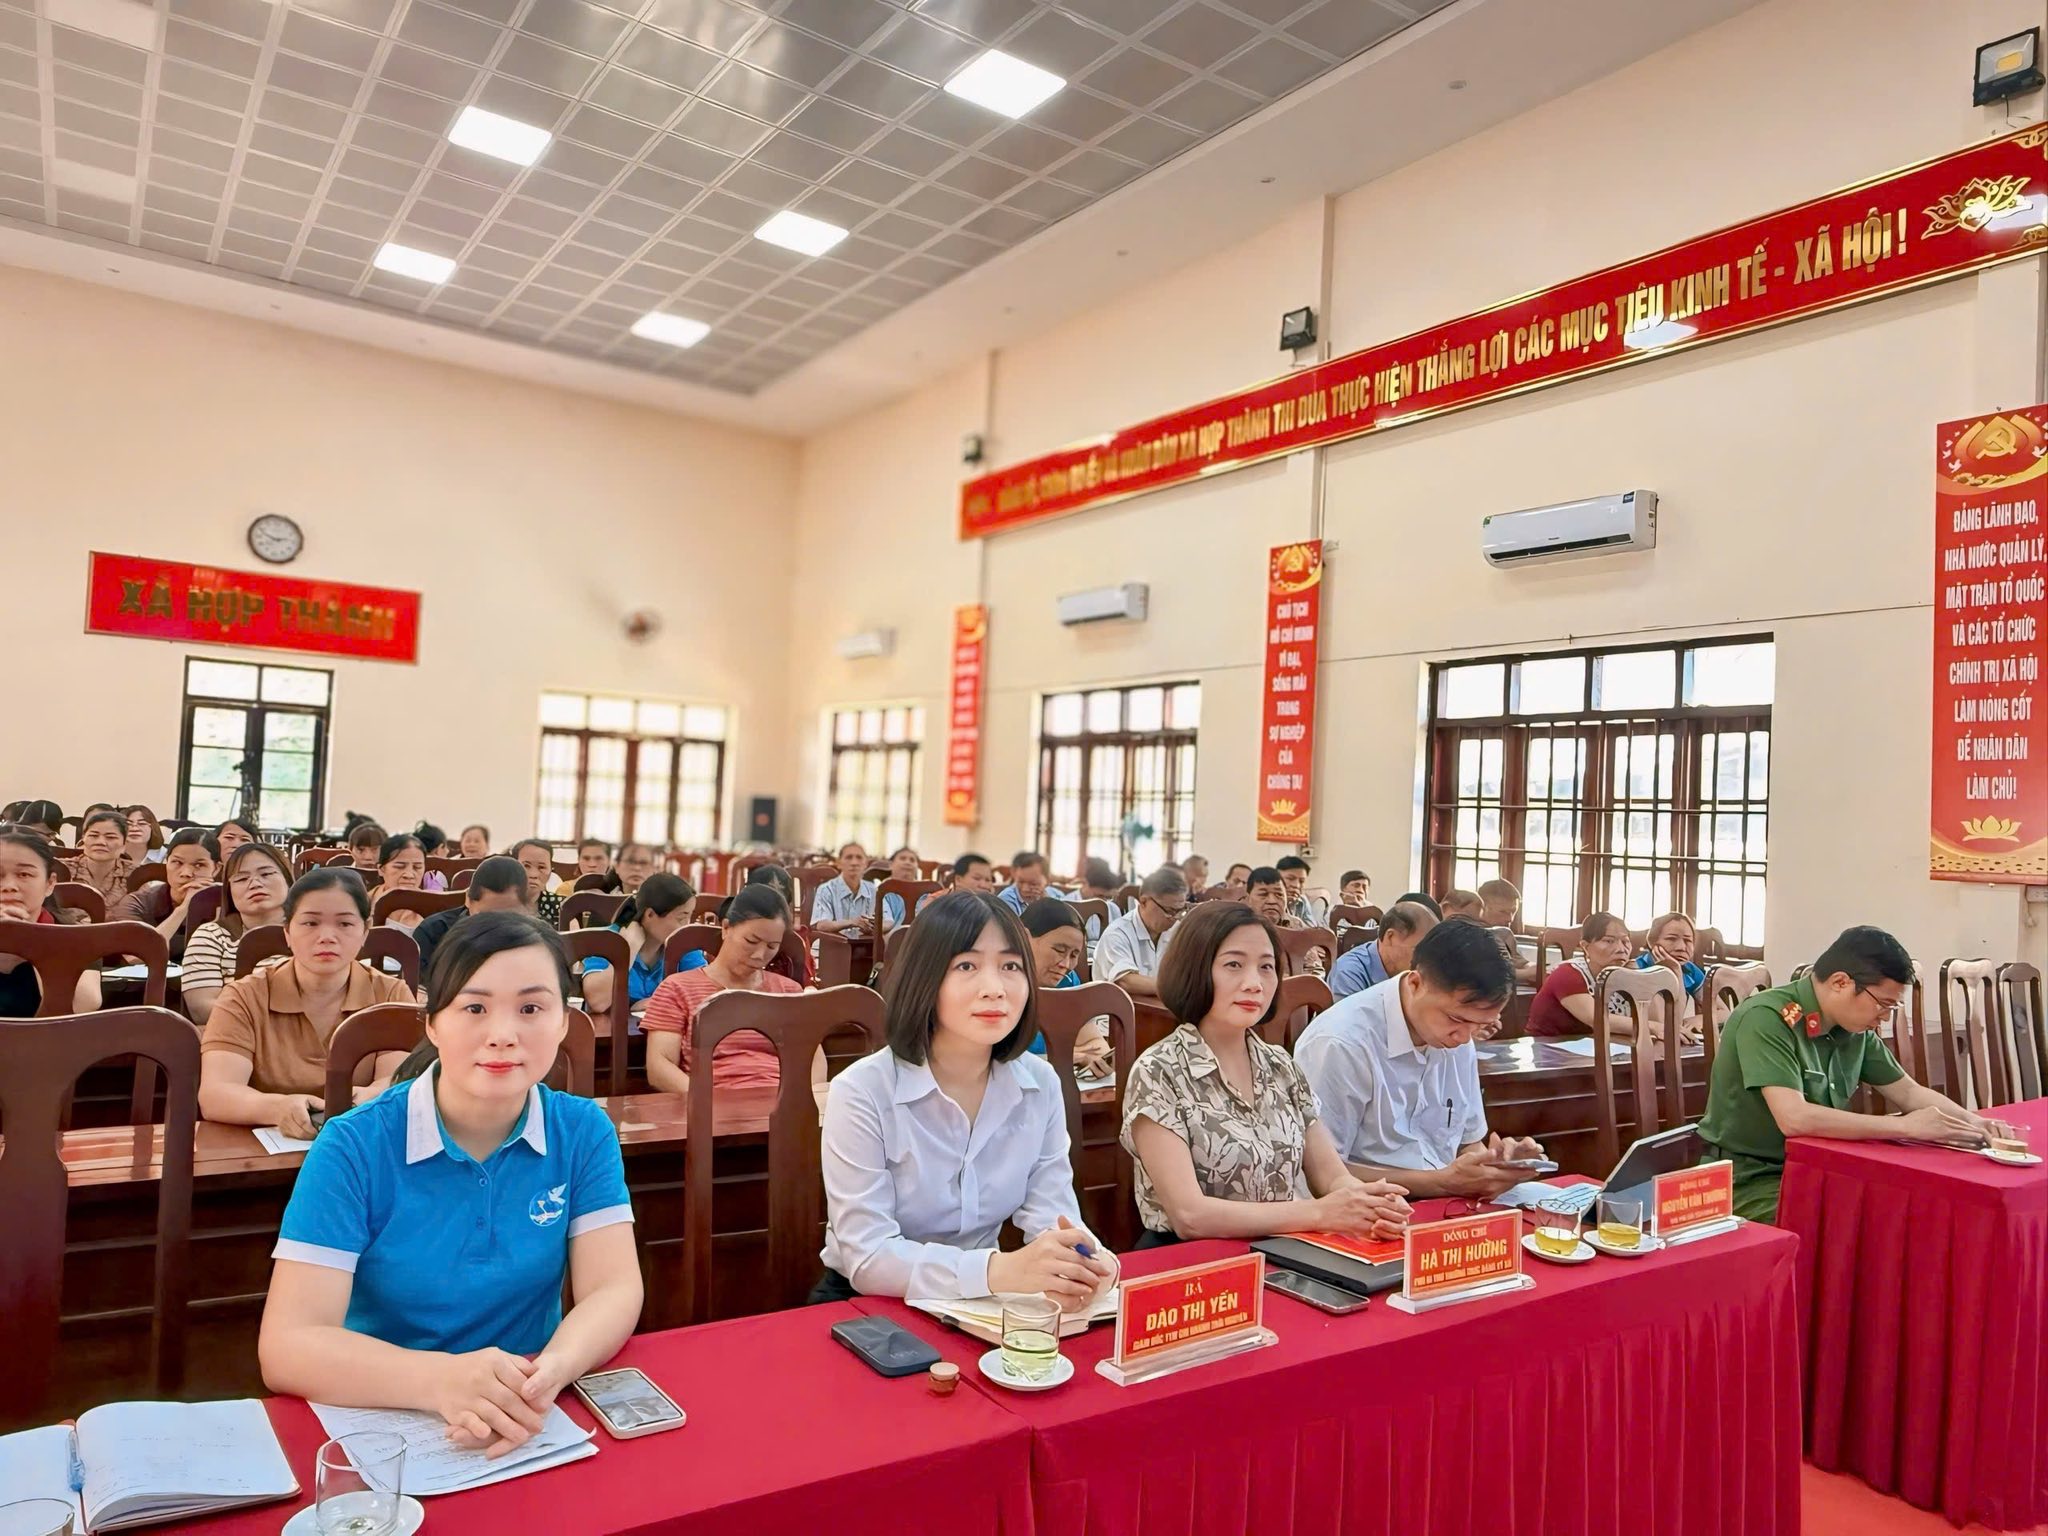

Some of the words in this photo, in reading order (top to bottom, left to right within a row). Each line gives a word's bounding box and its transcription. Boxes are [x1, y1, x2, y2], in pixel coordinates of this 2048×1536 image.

[1199, 420, 1225, 460] HỢP
[1227, 407, 1270, 448] THÀNH
[1273, 399, 1295, 435] THI
[1331, 375, 1370, 419] THỰC
[1374, 360, 1413, 408] HIỆN
[1417, 339, 1475, 393] THẮNG
[1479, 329, 1509, 379] LỢI
[1513, 314, 1555, 365] CÁC
[1559, 301, 1609, 353] MỤC
[1615, 282, 1664, 336] TIÊU
[1669, 264, 1730, 322] KINH
[1737, 237, 1770, 301] TẾ
[1793, 224, 1834, 285] XÃ
[1953, 501, 1982, 533] ĐẢNG
[1984, 501, 2012, 529] LÃNH
[2014, 499, 2039, 529] ĐẠO,
[1944, 543, 1966, 572] NHÀ
[1968, 540, 1997, 570] NƯỚC
[1999, 533, 2029, 568] QUẢN
[2031, 532, 2048, 564] LÝ,
[119, 573, 174, 619] XÃ
[186, 584, 265, 633] HỢP
[279, 594, 397, 641] THÀNH
[1945, 581, 1968, 613] MẶT
[1970, 578, 1998, 611] TRẬN
[1999, 571, 2014, 604] TỔ
[2015, 569, 2045, 605] QUỐC
[1952, 619, 1966, 646] VÀ
[1968, 617, 1989, 646] CÁC
[1991, 611, 2006, 644] TỔ
[2007, 613, 2036, 643] CHỨC
[1949, 656, 1981, 685] CHÍNH
[1983, 659, 2000, 687] TRỊ
[2002, 654, 2017, 682] XÃ
[2019, 652, 2038, 685] HỘI
[1954, 695, 1977, 723] LÀM
[1979, 692, 2009, 722] NÒNG
[2011, 688, 2032, 720] CỐT
[1278, 745, 1294, 766] CỦA
[1957, 729, 1972, 761] ĐỂ
[1973, 732, 2003, 761] NHÂN
[2005, 732, 2028, 760] DÂN
[1966, 771, 1989, 800] LÀM
[1992, 768, 2017, 800] CHỦ!
[1420, 1248, 1439, 1271] HÀ
[1442, 1247, 1462, 1267] THỊ
[1465, 1239, 1508, 1262] HƯỜNG
[1184, 1277, 1203, 1297] BÀ
[1146, 1307, 1178, 1331] ĐÀO
[1182, 1301, 1205, 1321] THỊ
[1209, 1289, 1238, 1314] YẾN
